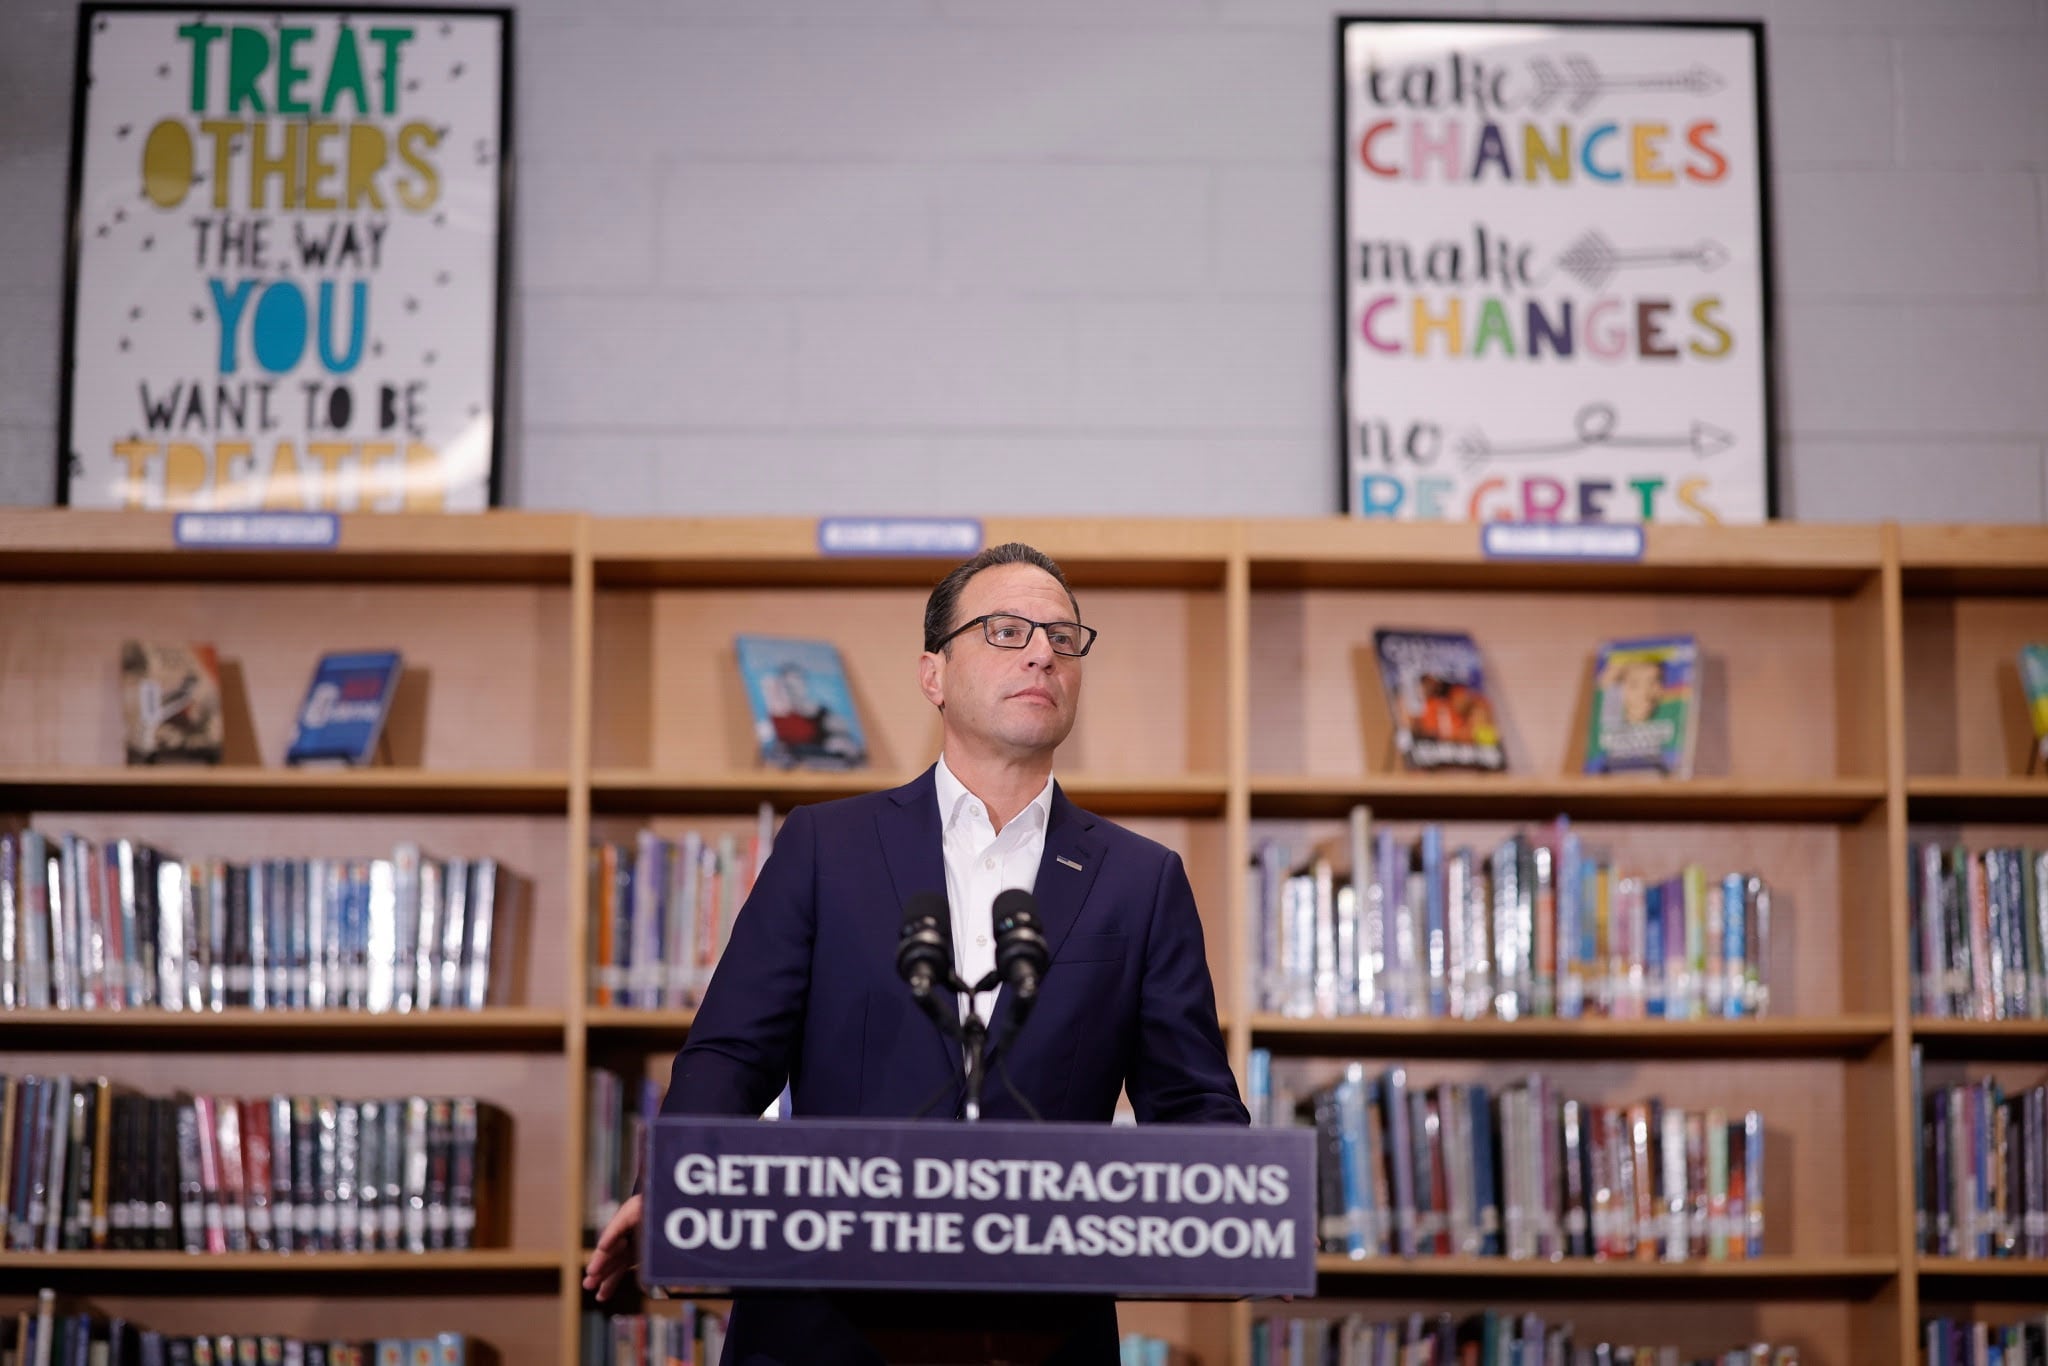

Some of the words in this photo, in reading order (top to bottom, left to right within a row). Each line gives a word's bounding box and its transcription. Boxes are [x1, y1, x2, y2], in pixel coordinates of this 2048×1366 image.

[178, 23, 415, 115] TREAT
[1368, 52, 1514, 112] take
[142, 118, 442, 212] OTHERS
[1360, 121, 1729, 182] CHANCES
[192, 219, 272, 270] THE
[296, 220, 388, 270] WAY
[1358, 224, 1541, 288] make
[207, 278, 369, 375] YOU
[1360, 297, 1734, 359] CHANGES
[140, 380, 277, 432] WANT
[302, 382, 354, 431] TO
[379, 383, 428, 434] BE
[1357, 417, 1443, 465] no
[1361, 475, 1722, 524] REGRETS
[674, 1153, 903, 1199] GETTING
[914, 1158, 1291, 1205] DISTRACTIONS
[664, 1207, 776, 1250] OUT
[782, 1209, 855, 1251] OF
[862, 1211, 965, 1252] THE
[972, 1213, 1297, 1259] CLASSROOM
